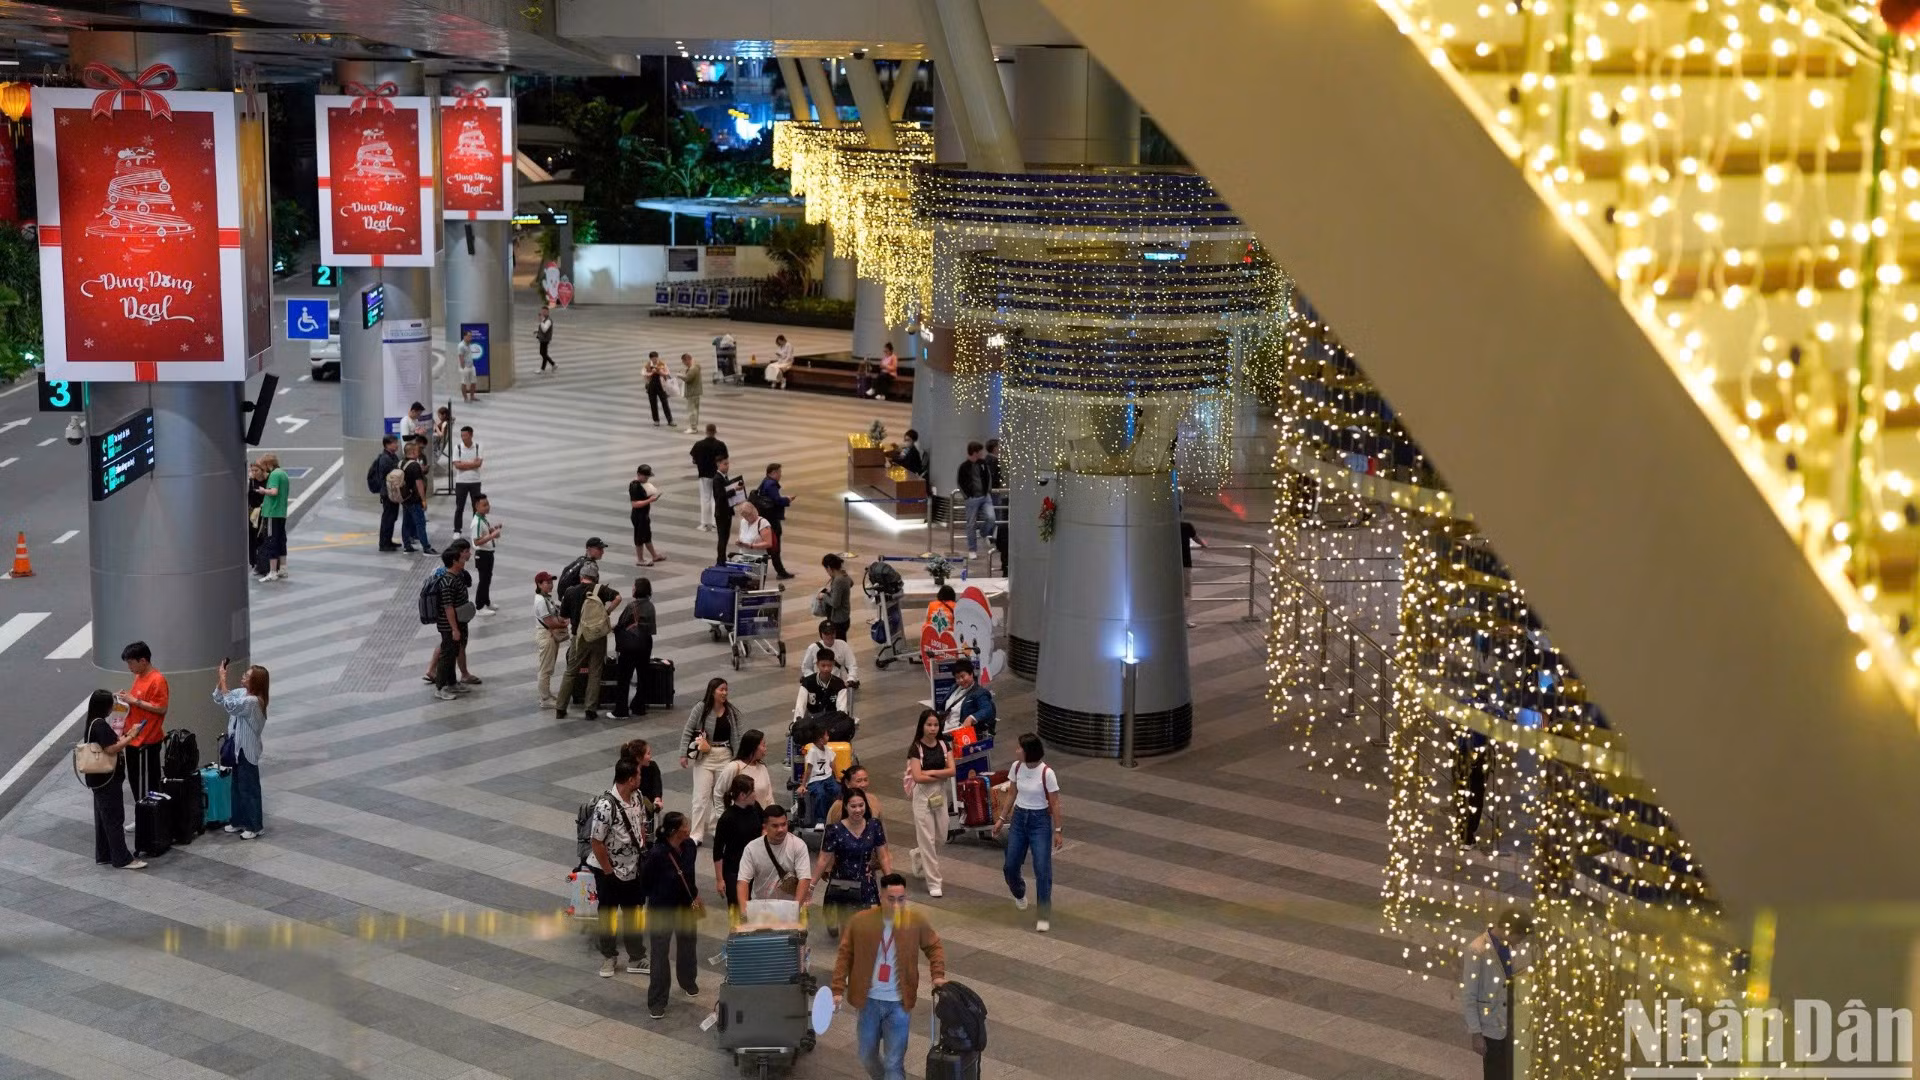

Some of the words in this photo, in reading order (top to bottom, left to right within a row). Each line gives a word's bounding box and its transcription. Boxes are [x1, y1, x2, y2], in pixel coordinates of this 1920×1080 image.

[446, 173, 473, 184] Ding
[462, 183, 493, 196] Deal
[340, 202, 380, 217] Ding
[362, 215, 405, 233] Deal
[317, 266, 331, 285] 2
[80, 272, 149, 298] Ding
[119, 295, 195, 325] Deal
[49, 380, 71, 407] 3
